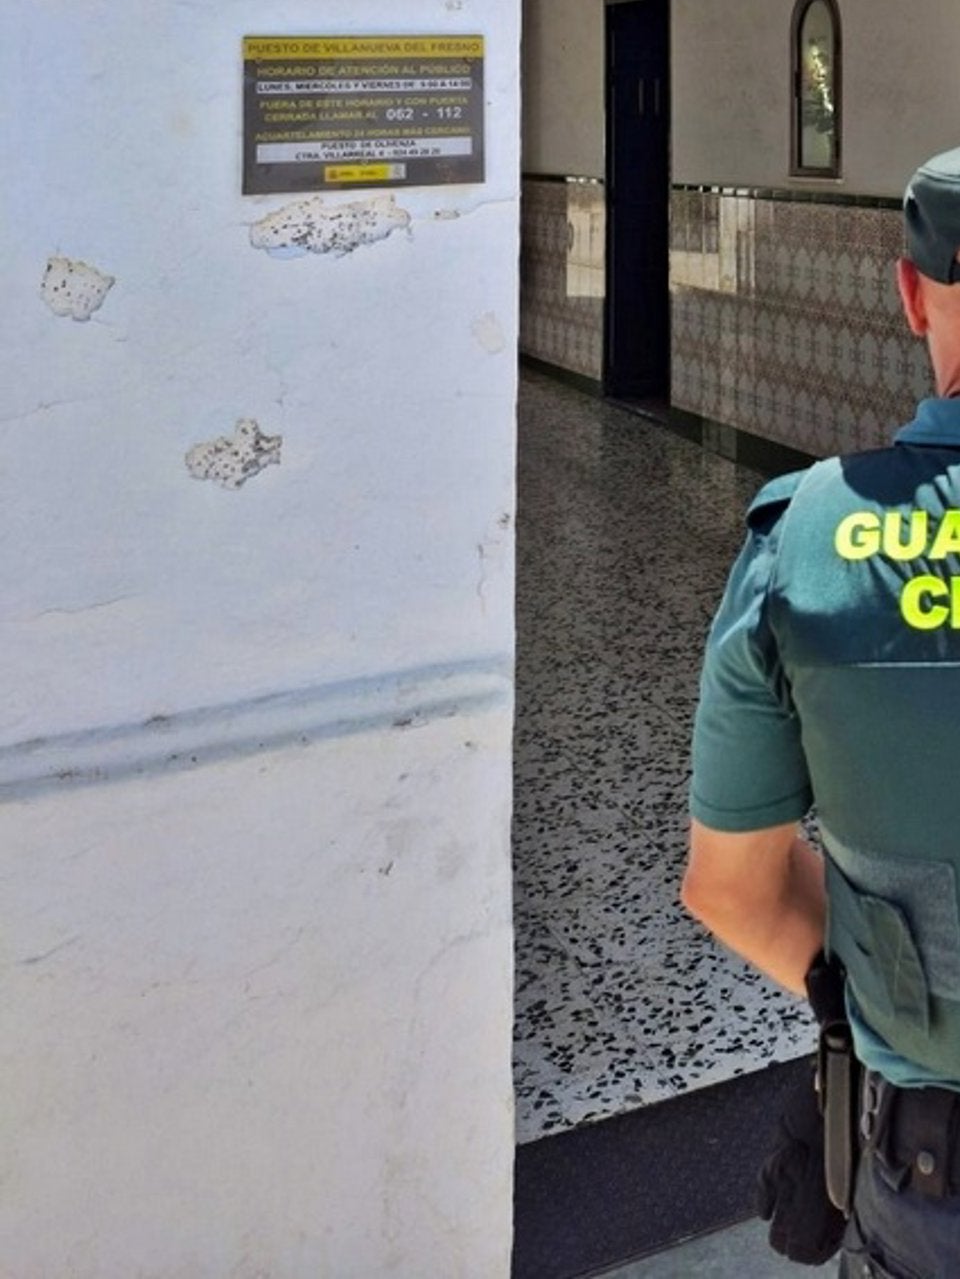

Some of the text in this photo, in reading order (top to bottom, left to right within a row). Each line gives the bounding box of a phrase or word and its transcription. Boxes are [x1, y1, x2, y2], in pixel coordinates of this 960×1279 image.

[248, 42, 480, 54] PUESTO DE VILLANUEVA DEL FRESNO
[257, 65, 317, 77] HORARIO
[319, 65, 336, 77] DE
[337, 62, 399, 76] ATENCIÓN
[401, 64, 417, 75] AL
[259, 99, 297, 110] FUERA
[299, 99, 313, 109] DE
[315, 98, 344, 108] ESTE
[346, 97, 393, 108] HORARIO
[403, 97, 427, 107] CON
[429, 96, 469, 106] PUERTA
[264, 111, 317, 122] CERRADA
[386, 108, 414, 121] 062
[436, 106, 462, 119] 112
